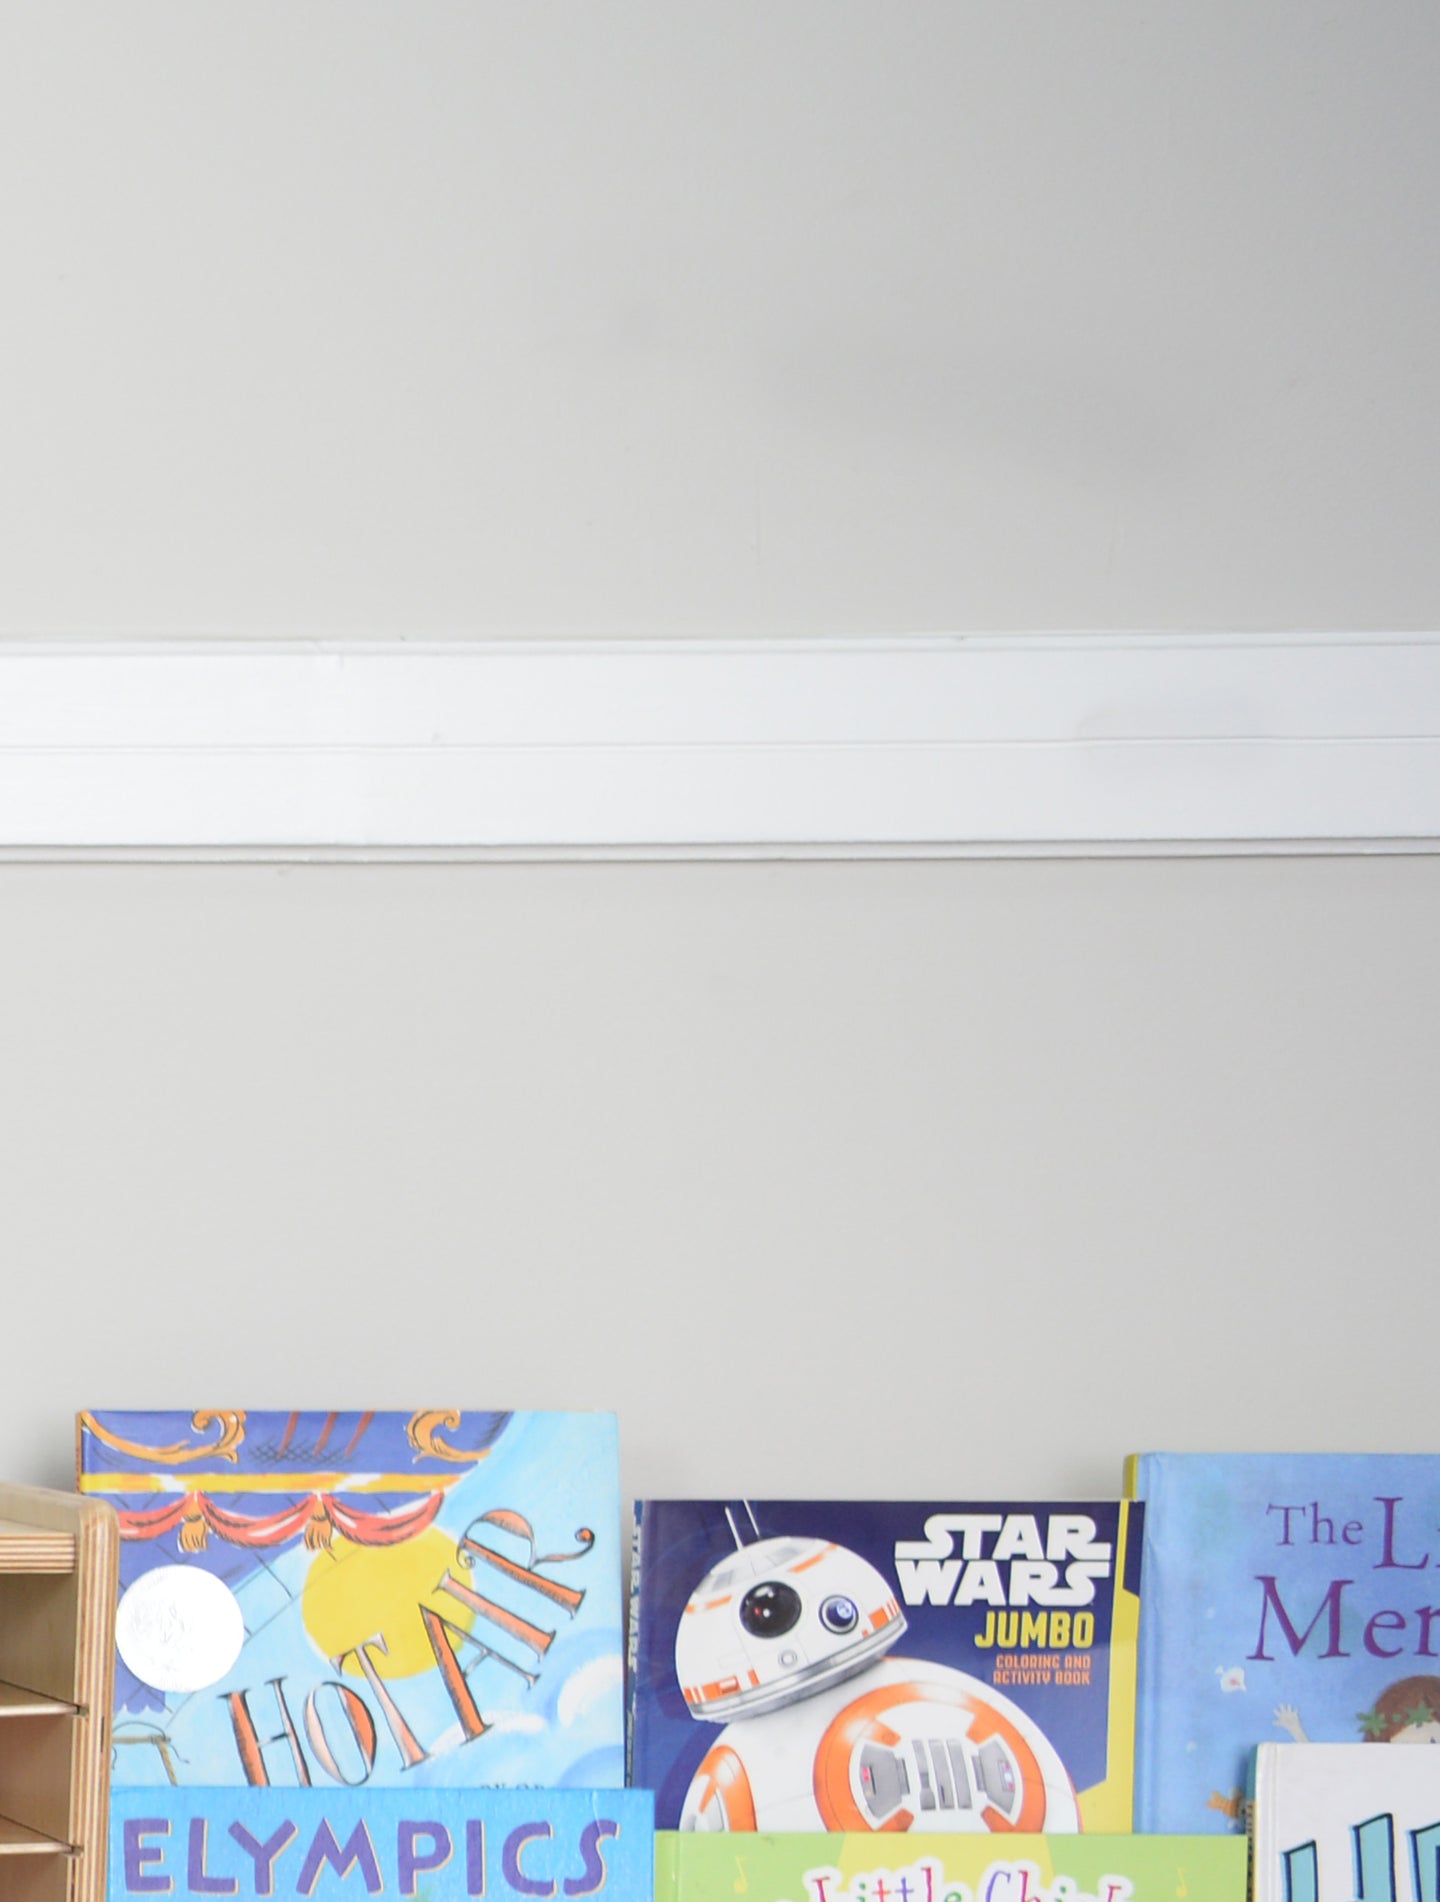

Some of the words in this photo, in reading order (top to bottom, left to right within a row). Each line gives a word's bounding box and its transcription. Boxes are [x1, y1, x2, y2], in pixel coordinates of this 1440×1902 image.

[895, 1513, 1112, 1560] STAR
[1266, 1501, 1364, 1546] The
[1373, 1496, 1440, 1570] L
[895, 1560, 1111, 1607] WARS
[218, 1632, 431, 1787] HOT
[418, 1508, 594, 1744] AIR
[974, 1610, 1095, 1649] JUMBO
[993, 1670, 1051, 1685] ACTIVITY
[1055, 1671, 1091, 1686] BOOK
[996, 1654, 1060, 1670] COLORING
[1065, 1654, 1092, 1670] AND
[123, 1817, 621, 1897] ELYMPICS
